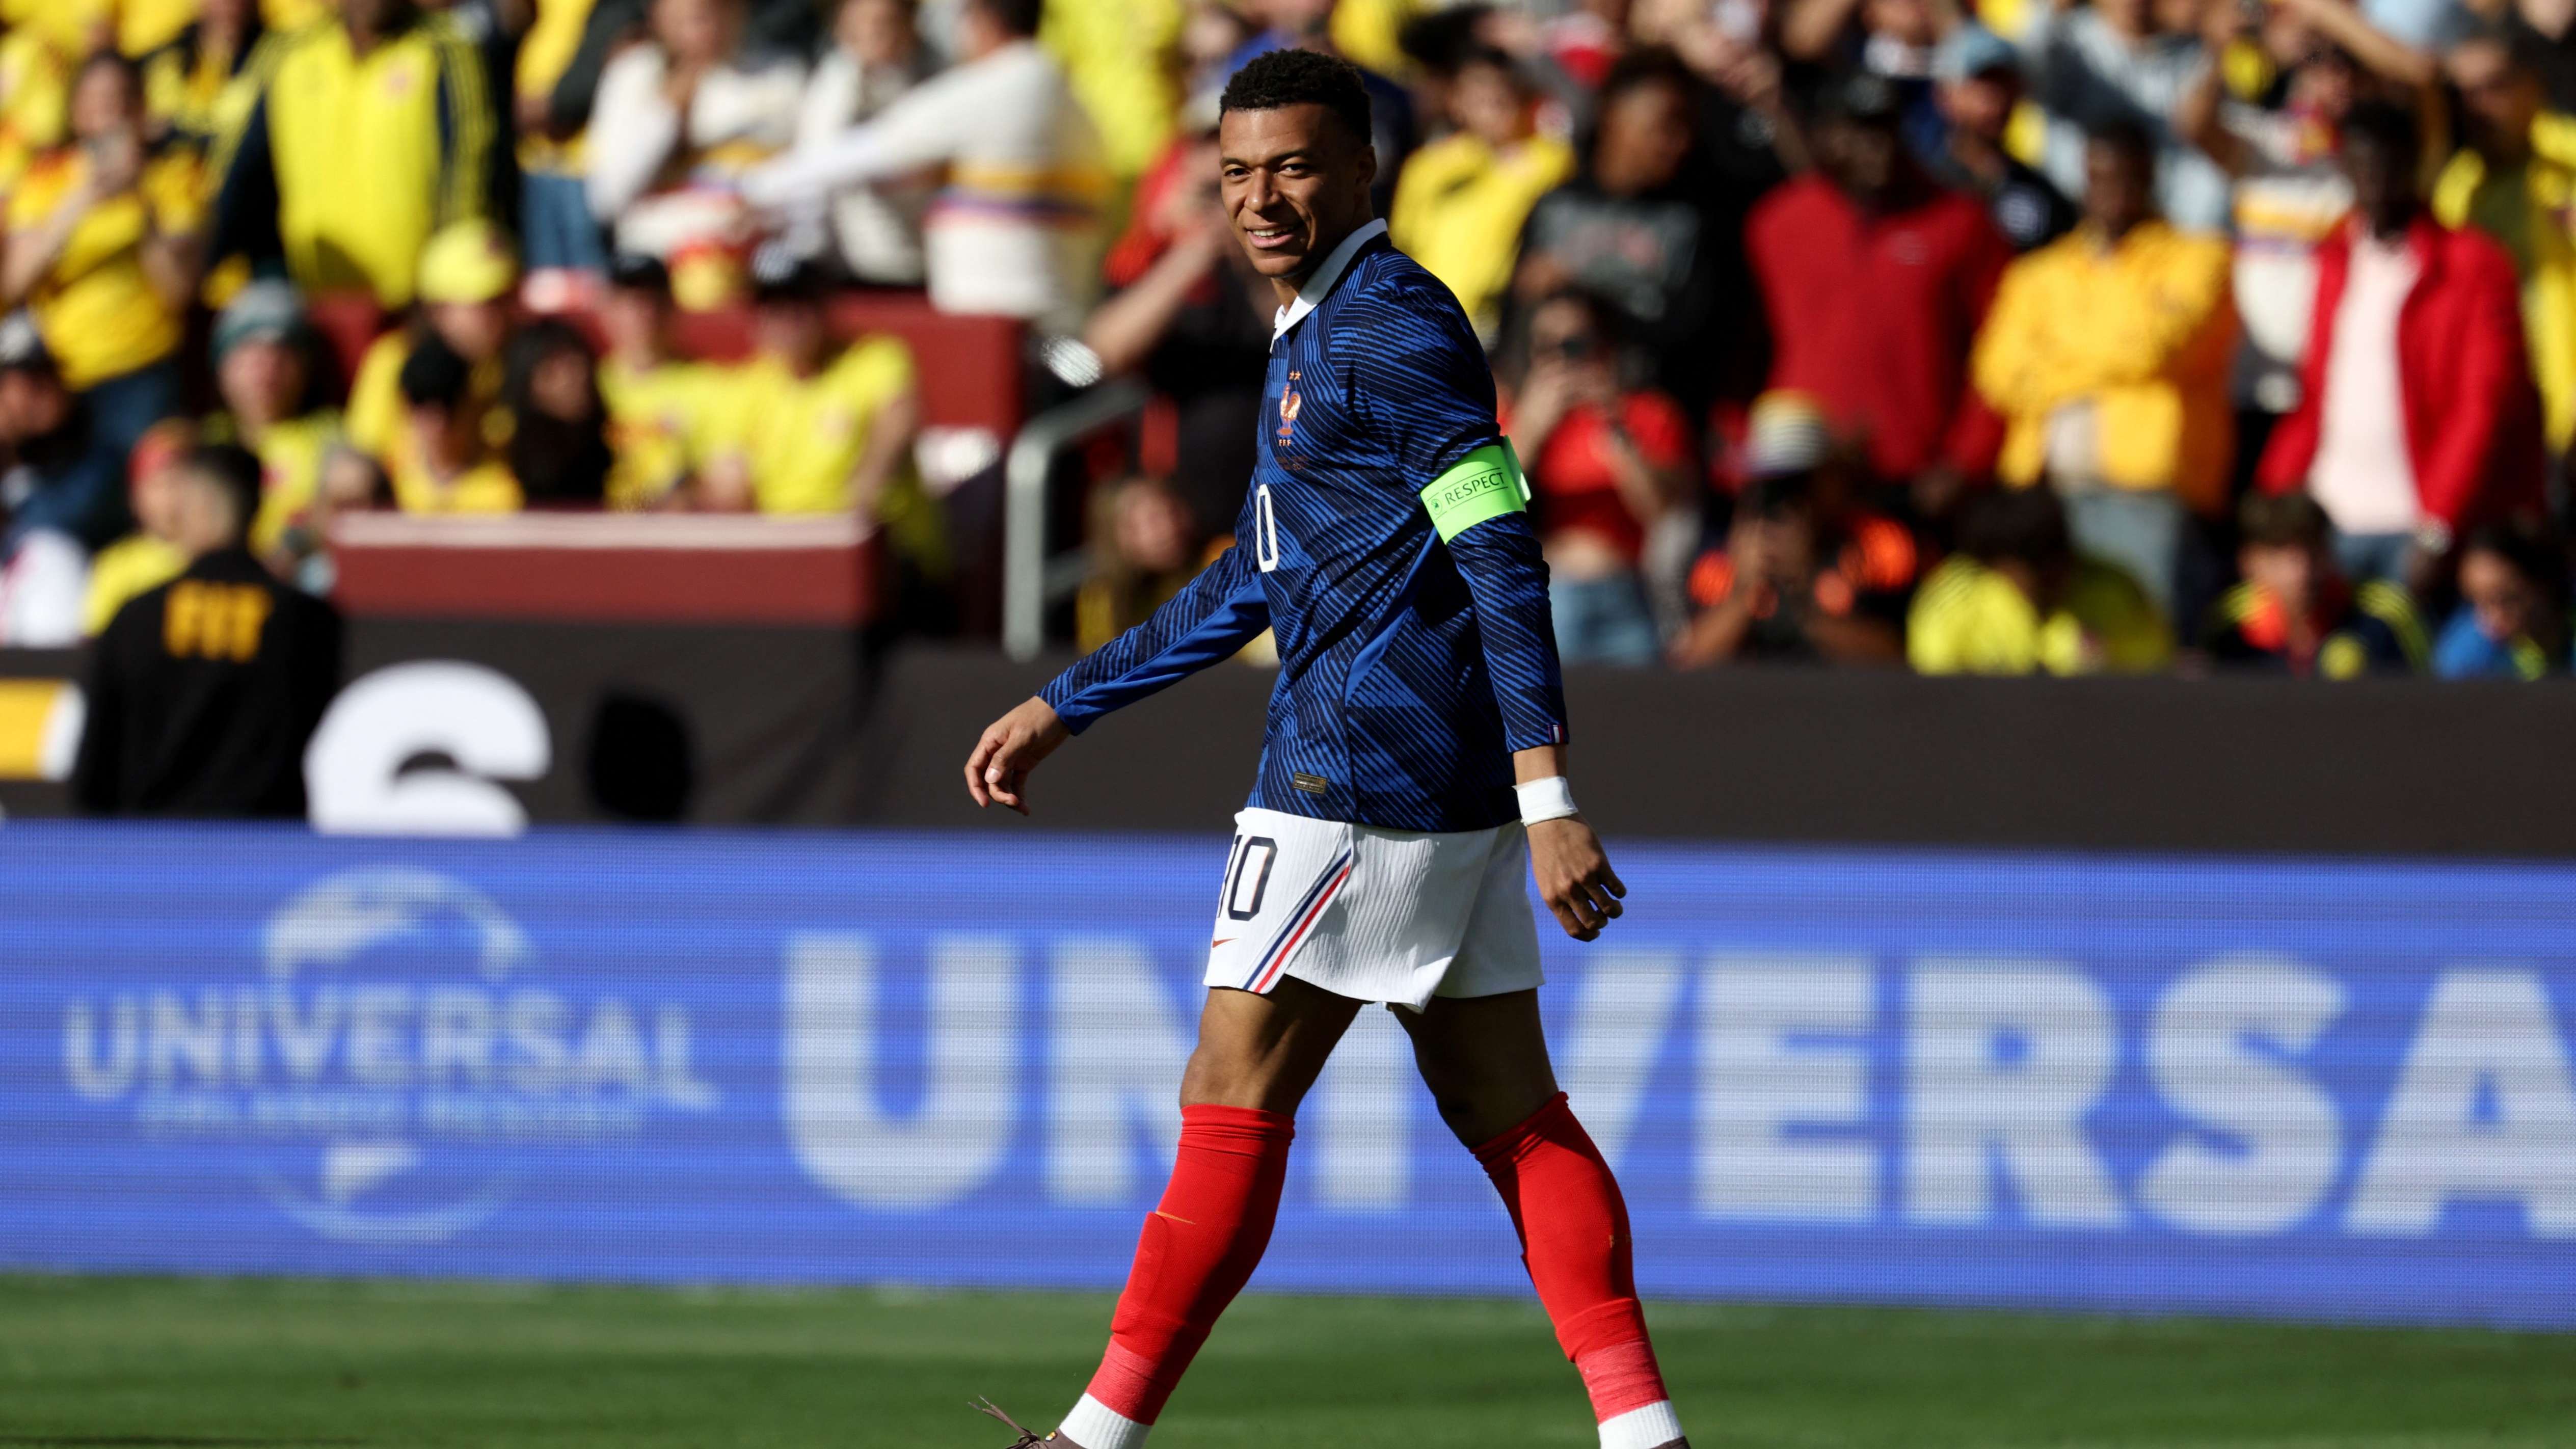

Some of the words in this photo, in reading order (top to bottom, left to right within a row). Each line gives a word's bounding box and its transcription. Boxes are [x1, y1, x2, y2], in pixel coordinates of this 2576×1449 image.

[1256, 484, 1279, 573] 0
[1445, 472, 1505, 505] RESPECT
[60, 982, 722, 1111] UNIVERSAL
